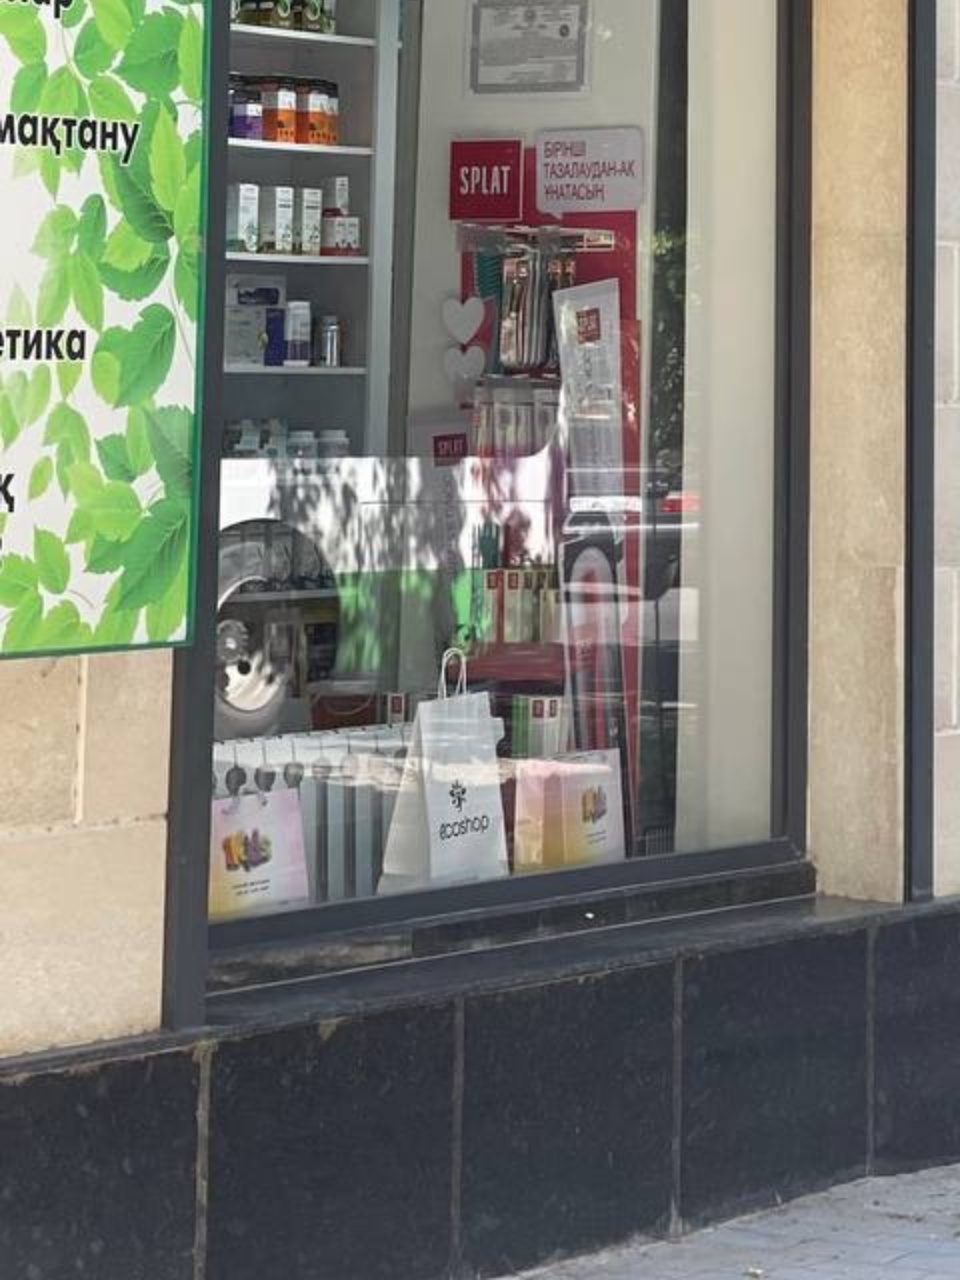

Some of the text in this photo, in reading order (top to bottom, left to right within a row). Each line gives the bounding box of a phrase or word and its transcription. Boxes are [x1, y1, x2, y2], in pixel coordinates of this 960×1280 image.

[459, 165, 511, 195] SPLAT
[0, 329, 86, 360] тика
[440, 815, 490, 840] ecoshop
